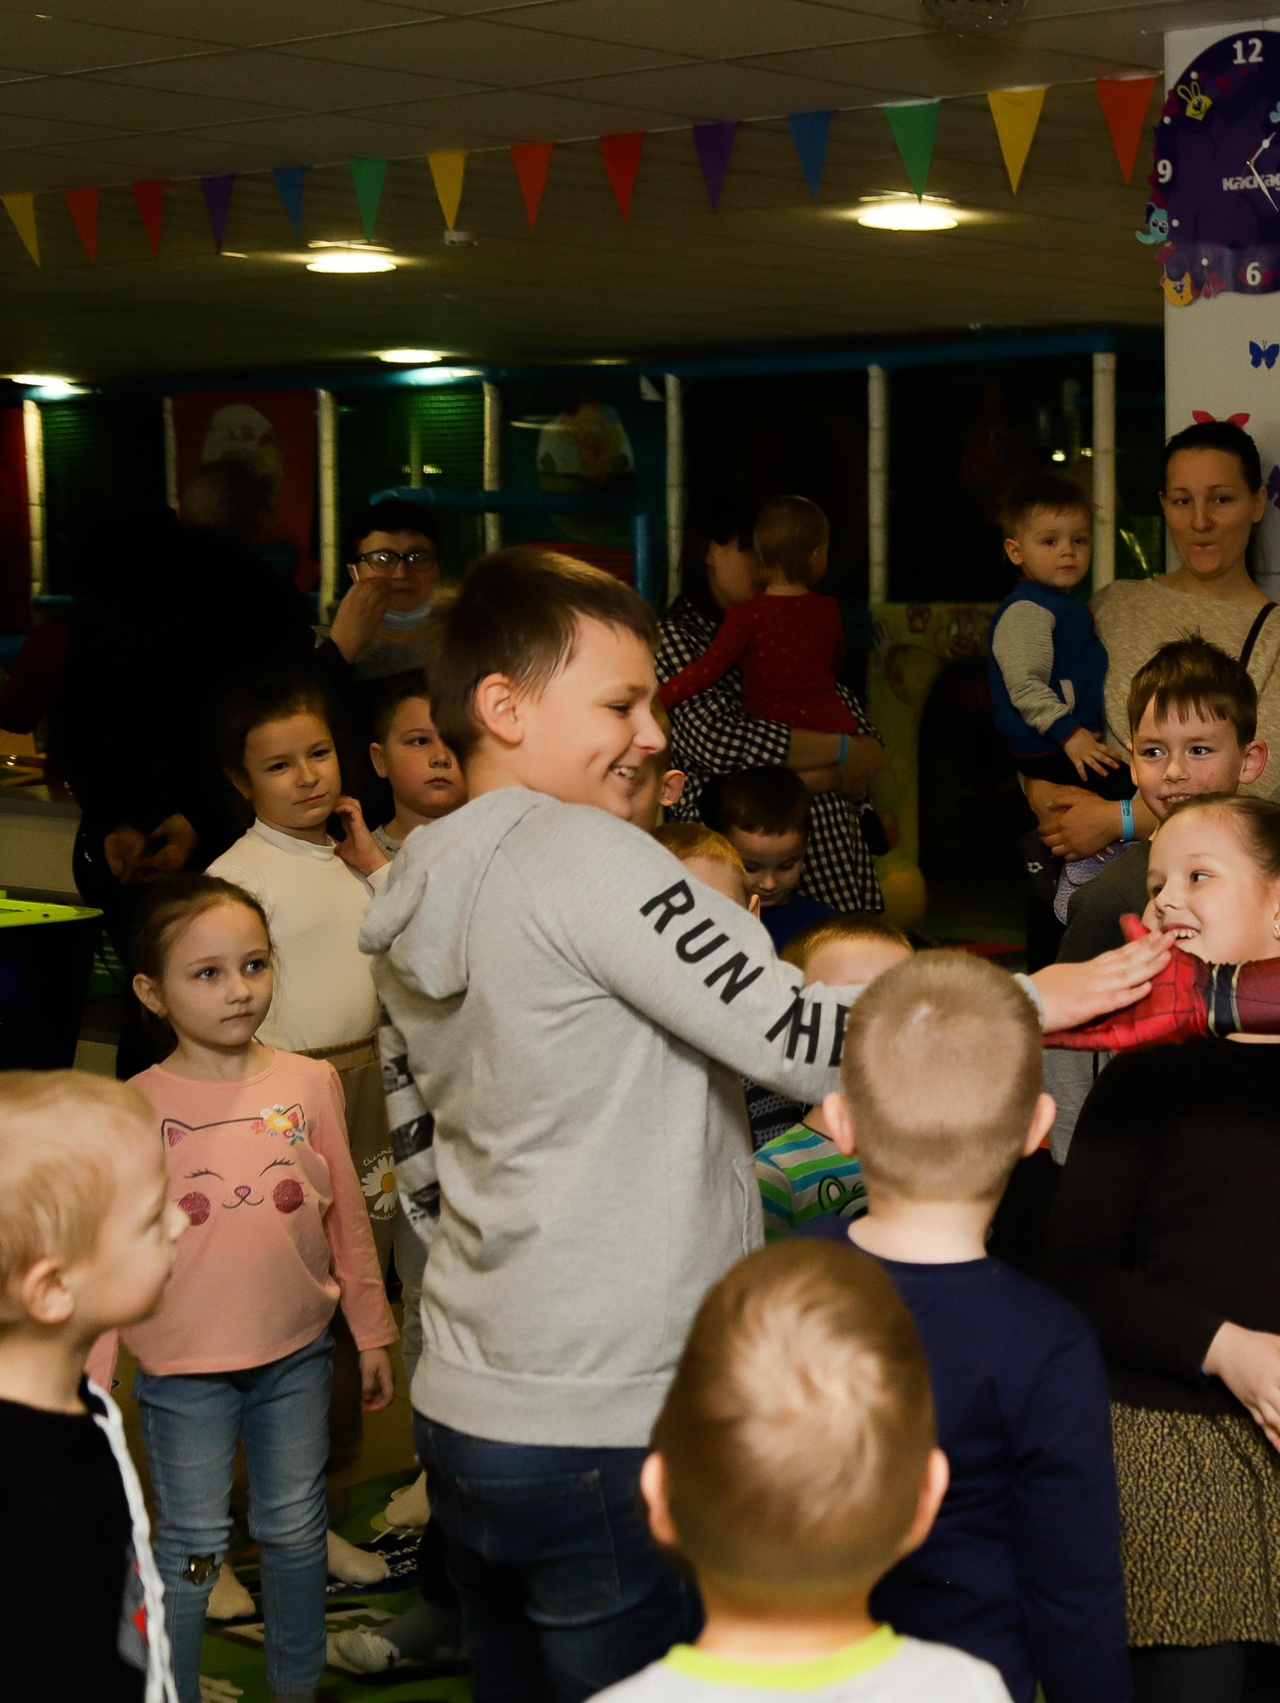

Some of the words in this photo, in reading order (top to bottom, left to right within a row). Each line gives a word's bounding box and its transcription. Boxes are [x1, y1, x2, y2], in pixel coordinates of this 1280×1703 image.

[1232, 38, 1263, 64] 12
[1157, 159, 1172, 183] 9
[1246, 262, 1261, 286] 6
[638, 878, 765, 1005] RUN
